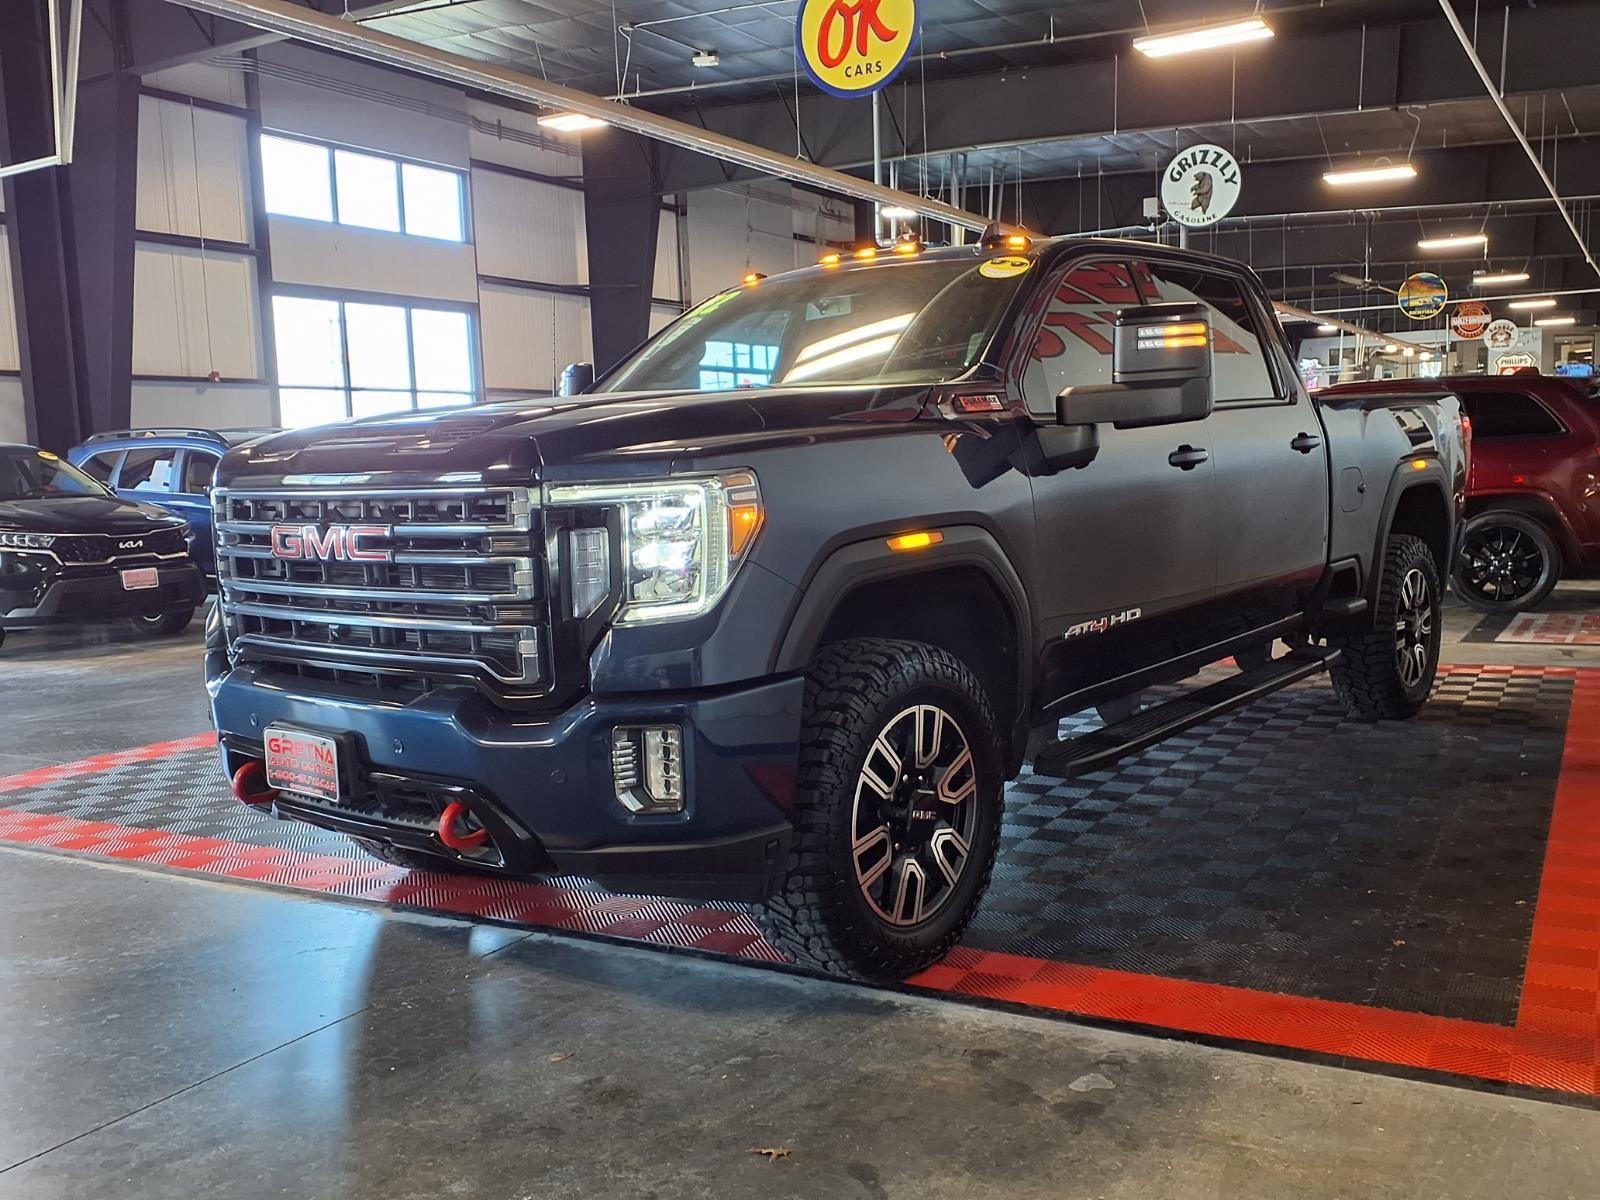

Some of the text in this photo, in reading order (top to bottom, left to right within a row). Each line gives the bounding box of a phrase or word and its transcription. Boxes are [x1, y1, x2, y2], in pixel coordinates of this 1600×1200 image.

[817, 0, 899, 69] OK
[844, 60, 882, 78] CARS
[1169, 149, 1238, 186] GRIZZLY
[1173, 210, 1218, 224] GASOLINE
[1500, 357, 1528, 365] PHILLIPS
[119, 540, 143, 549] KIA
[271, 525, 393, 561] GMC
[1064, 607, 1141, 639] AT4 HD
[268, 737, 334, 764] GRETNA
[269, 755, 336, 777] AUTO OUTLET
